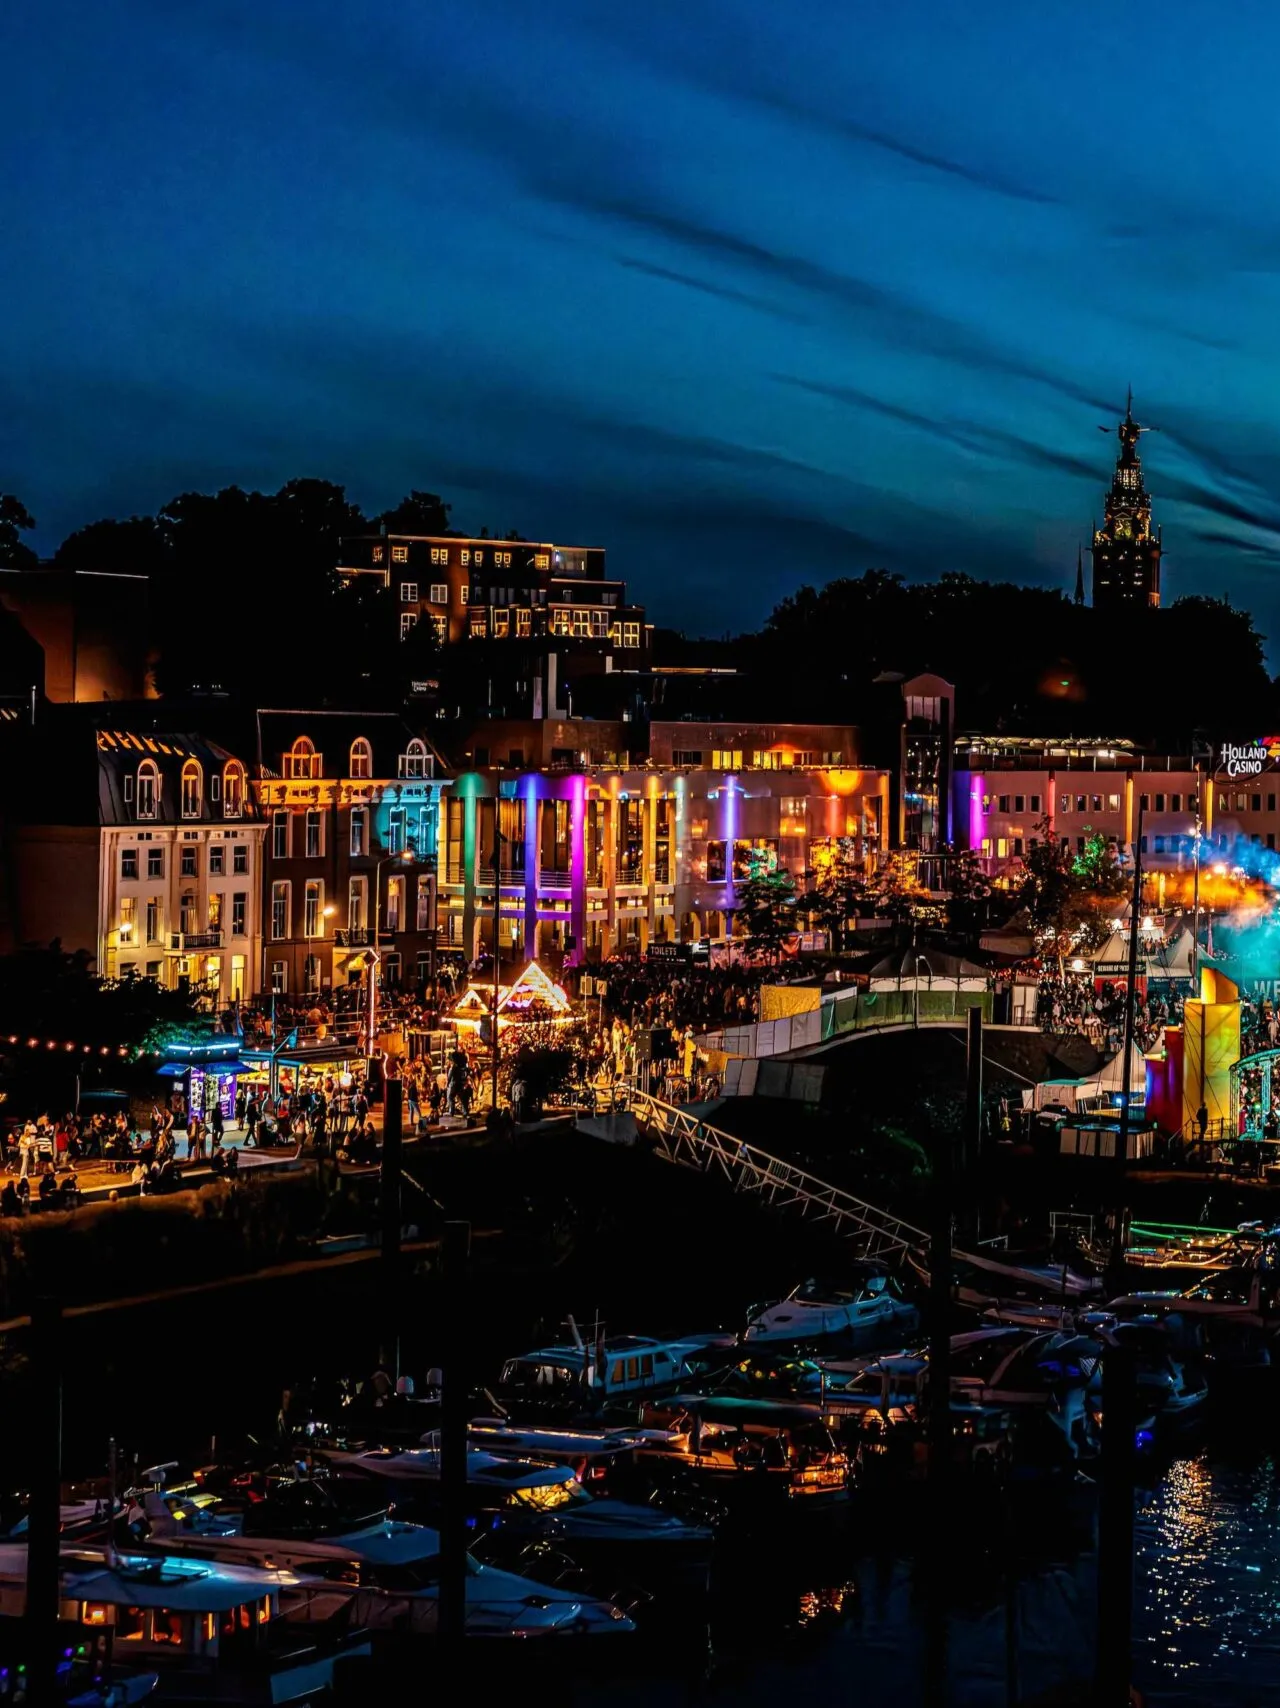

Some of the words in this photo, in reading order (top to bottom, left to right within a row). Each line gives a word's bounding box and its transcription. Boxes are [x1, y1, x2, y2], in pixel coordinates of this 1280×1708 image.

[1221, 743, 1267, 763] HOLLAND
[1227, 759, 1262, 777] CASINO
[651, 946, 677, 956] TOILETS
